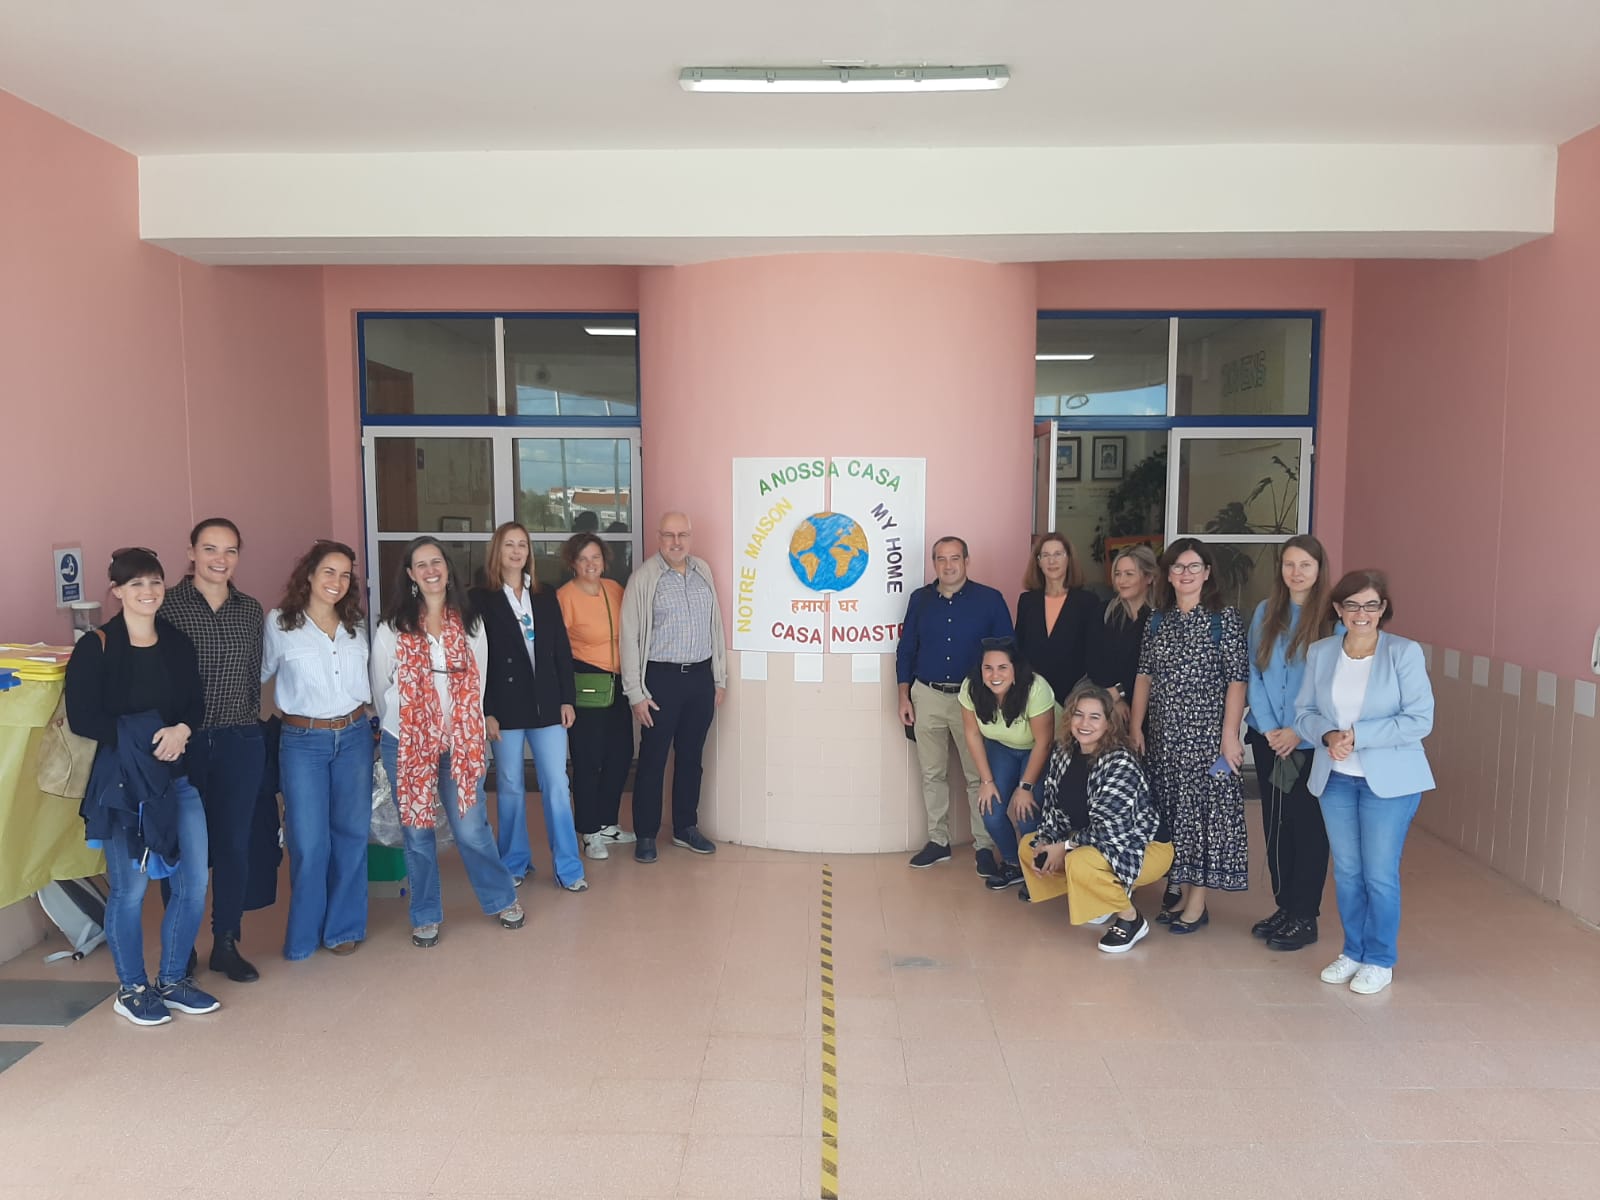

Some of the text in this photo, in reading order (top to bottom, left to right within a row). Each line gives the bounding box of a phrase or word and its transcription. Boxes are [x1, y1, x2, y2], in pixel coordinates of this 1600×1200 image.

[847, 459, 901, 493] CASA
[737, 496, 793, 633] NOTRE MAISON
[870, 502, 903, 593] MY HOME
[838, 599, 859, 612] घर
[771, 621, 823, 644] CASA
